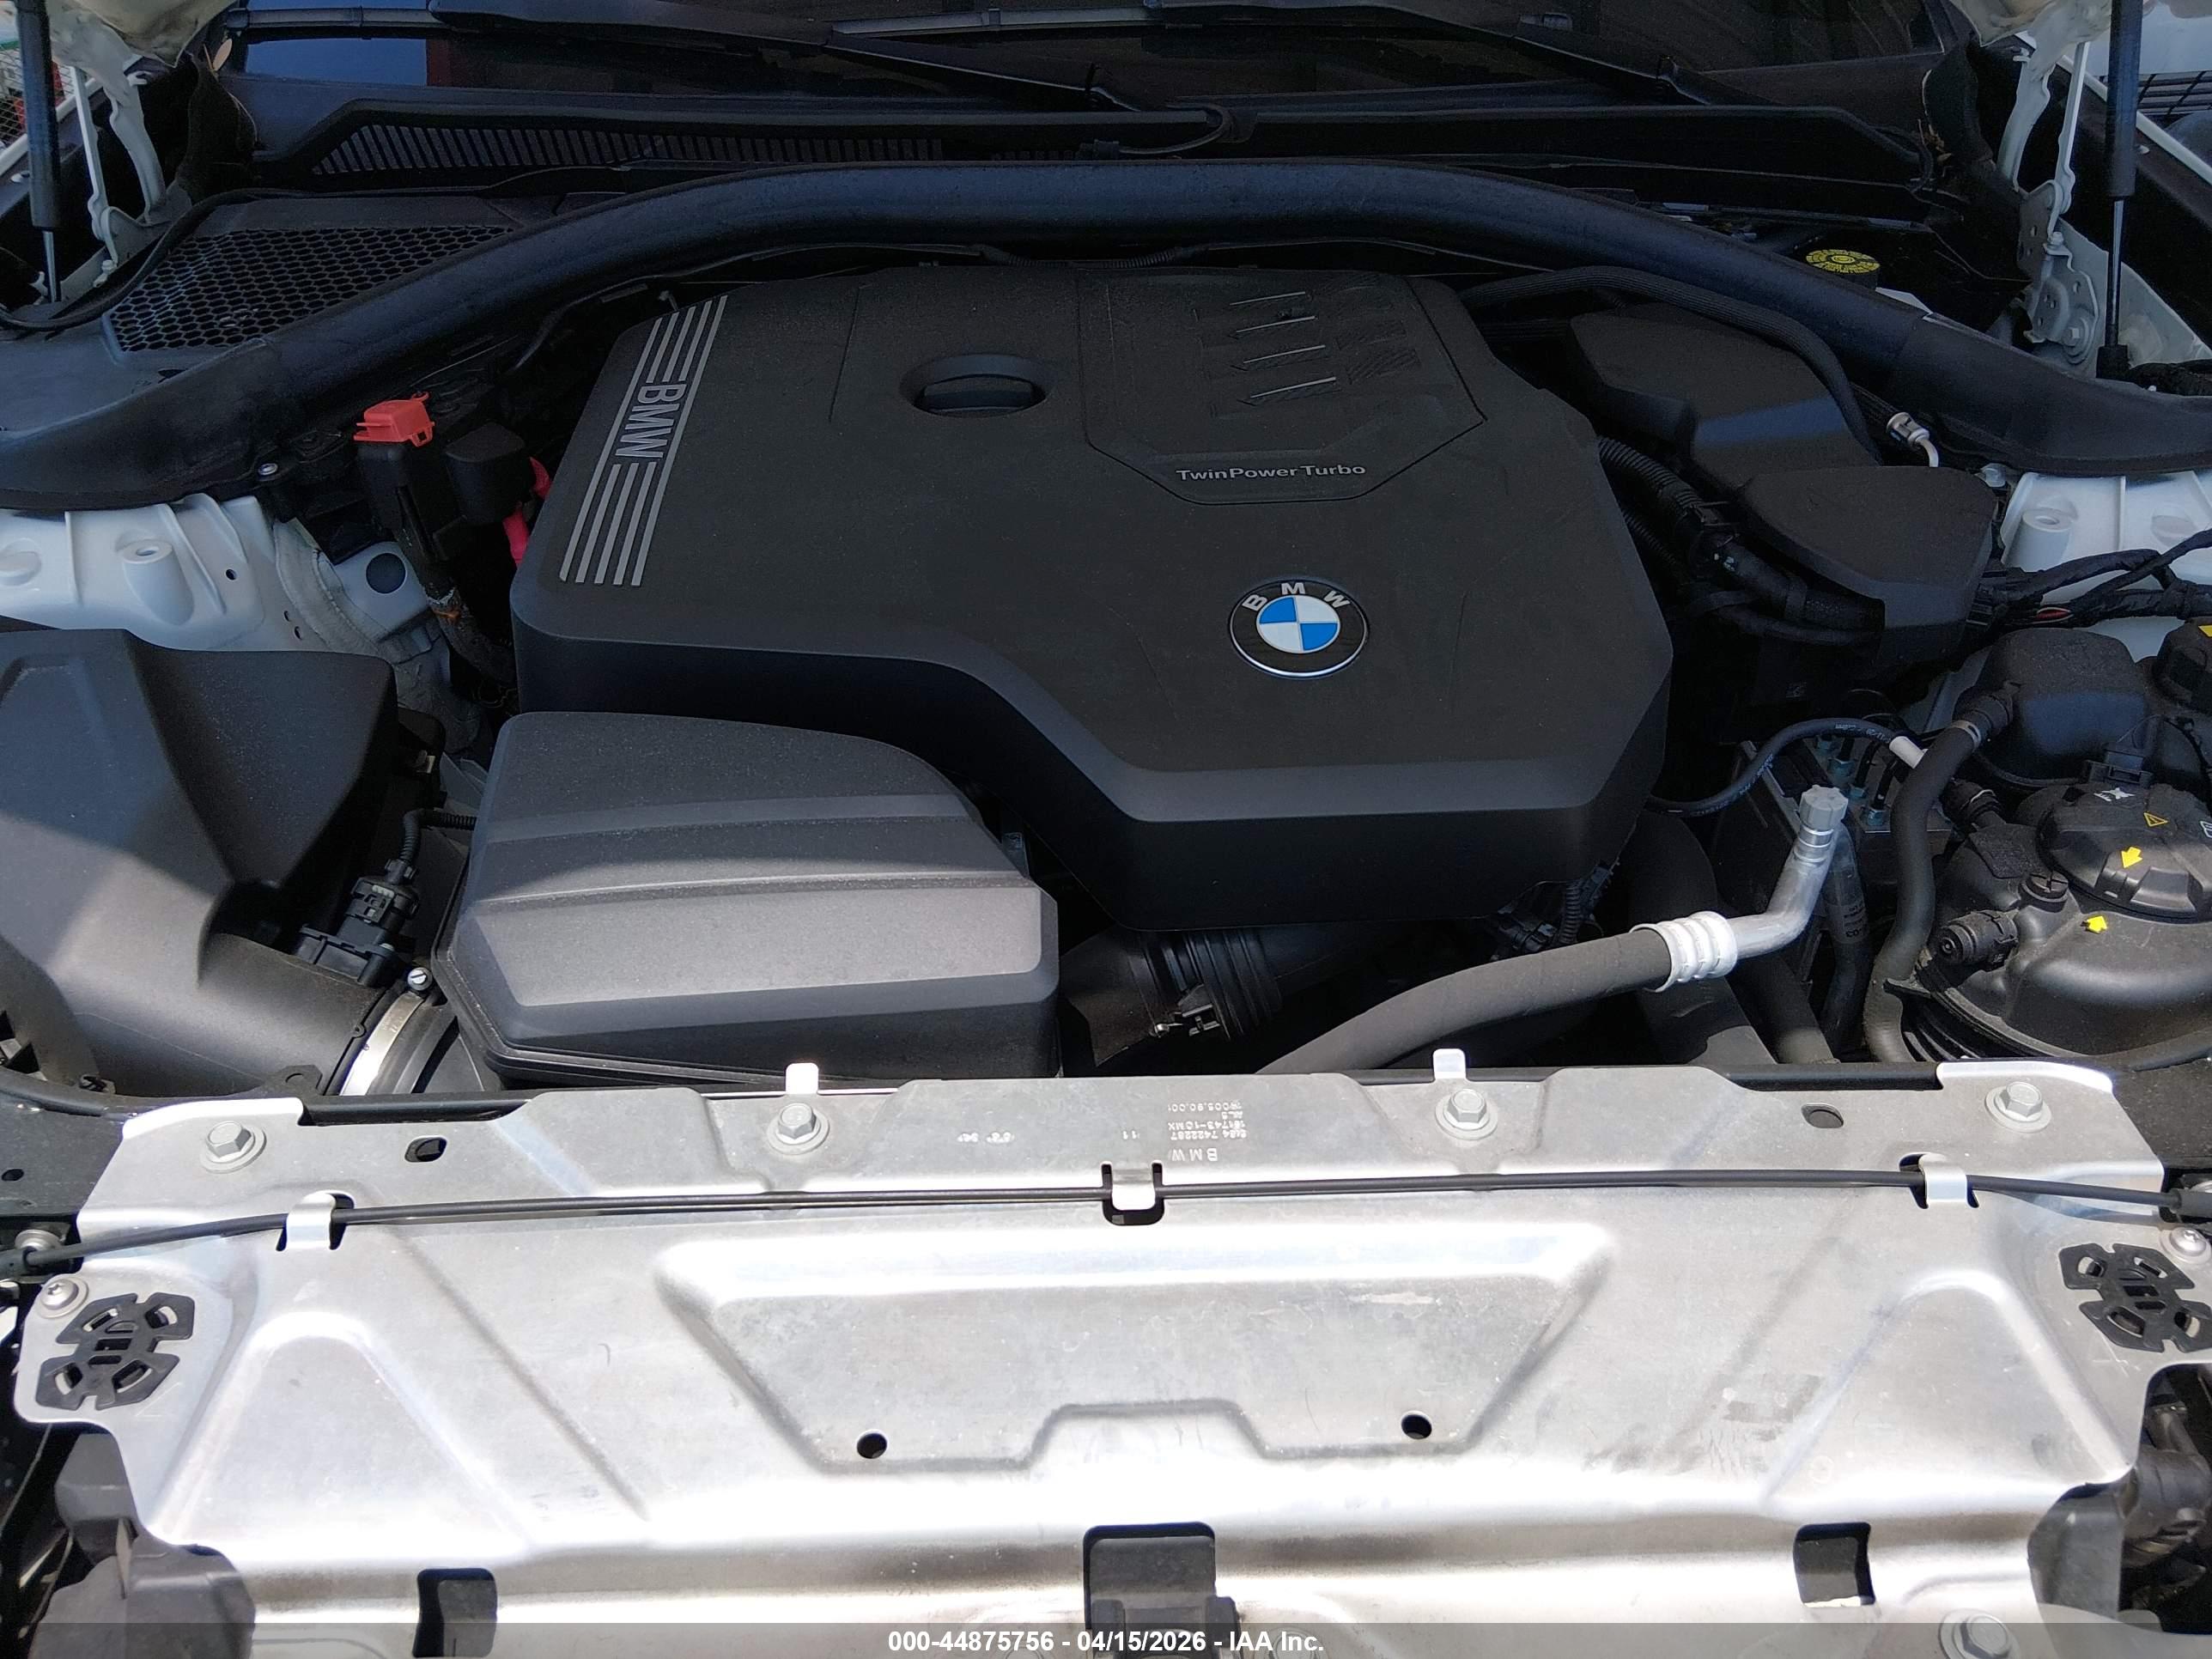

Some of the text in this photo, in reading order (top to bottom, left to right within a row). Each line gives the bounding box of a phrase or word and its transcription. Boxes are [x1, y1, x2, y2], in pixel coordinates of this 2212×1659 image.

[615, 384, 686, 459] BMW
[1242, 582, 1350, 611] BMW
[1169, 1148, 1218, 1162] BMW
